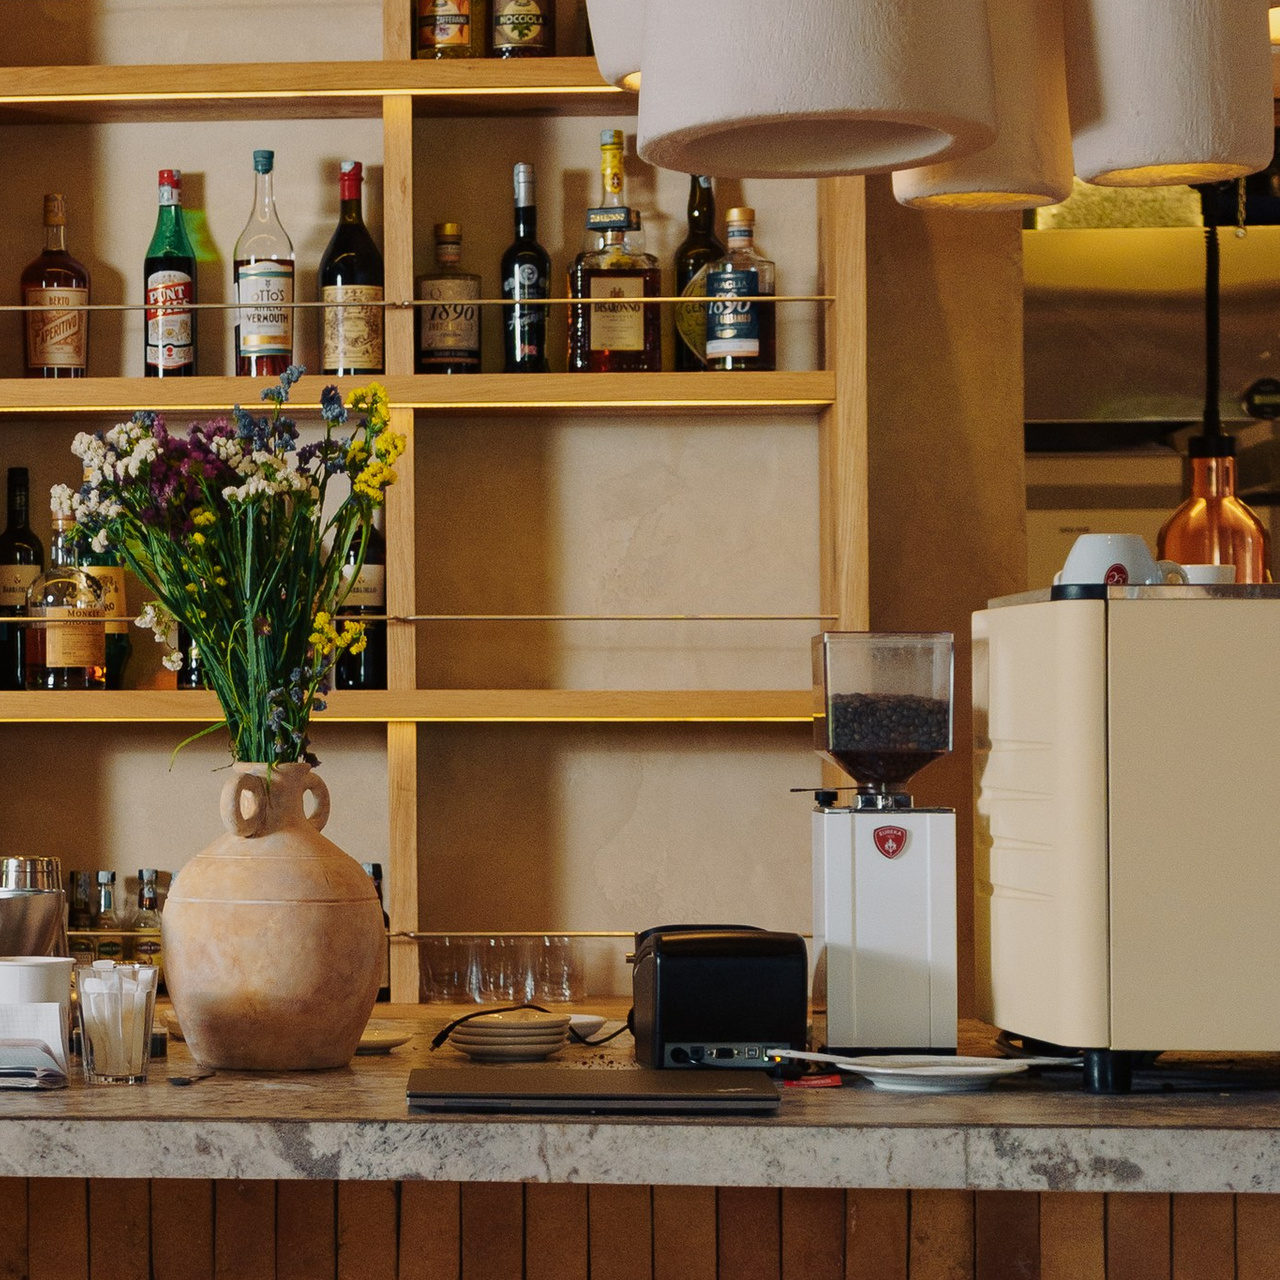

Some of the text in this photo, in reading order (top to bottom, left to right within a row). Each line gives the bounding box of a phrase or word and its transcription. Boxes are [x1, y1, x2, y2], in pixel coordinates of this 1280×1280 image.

[500, 14, 543, 24] NOCCIOLA
[150, 285, 185, 304] PUNT
[48, 296, 70, 306] BERTO
[594, 302, 641, 313] DISARONNO
[246, 313, 289, 324] VERMOUTH
[40, 317, 78, 346] APERITIVO
[67, 609, 100, 618] MONKEY
